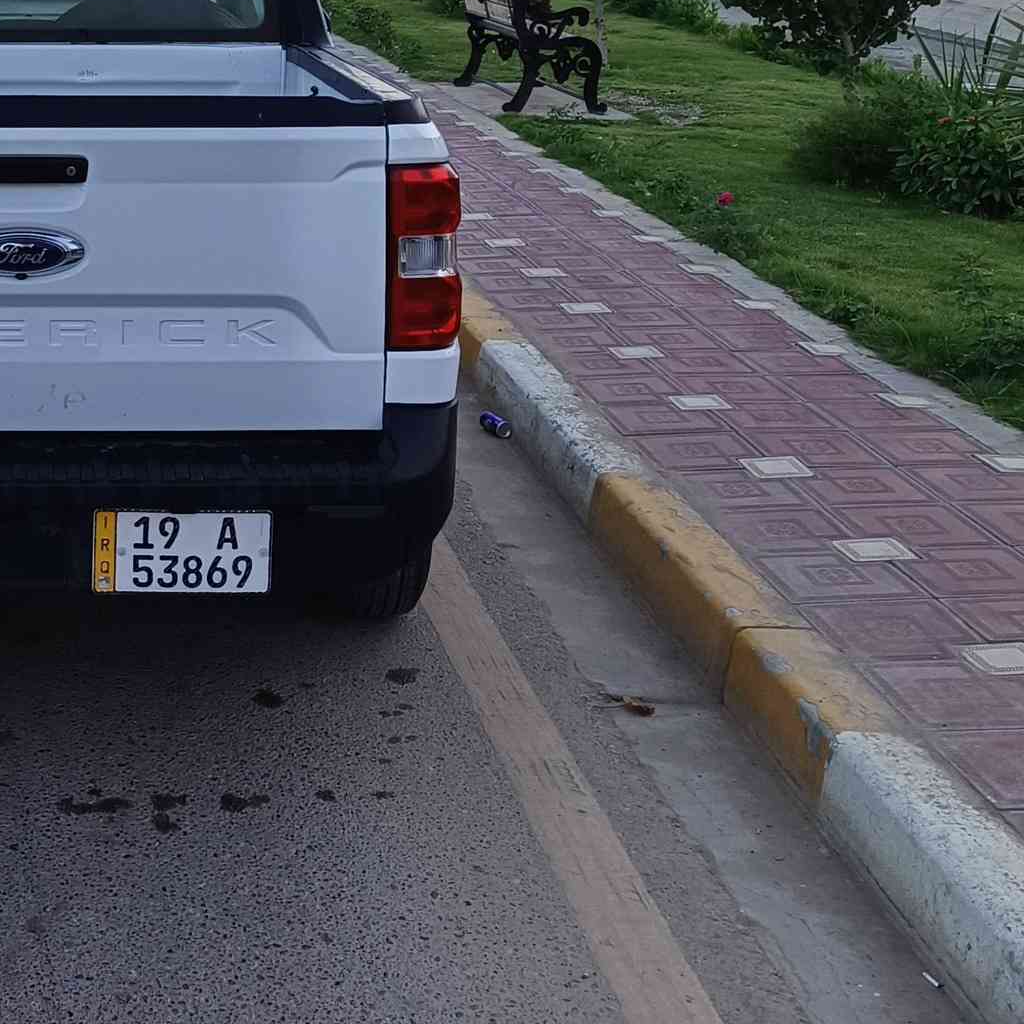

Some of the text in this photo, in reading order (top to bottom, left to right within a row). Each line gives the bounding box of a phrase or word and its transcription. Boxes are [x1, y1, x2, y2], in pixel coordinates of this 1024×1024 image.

[133, 516, 239, 550] 19 A
[132, 554, 253, 589] 53869
